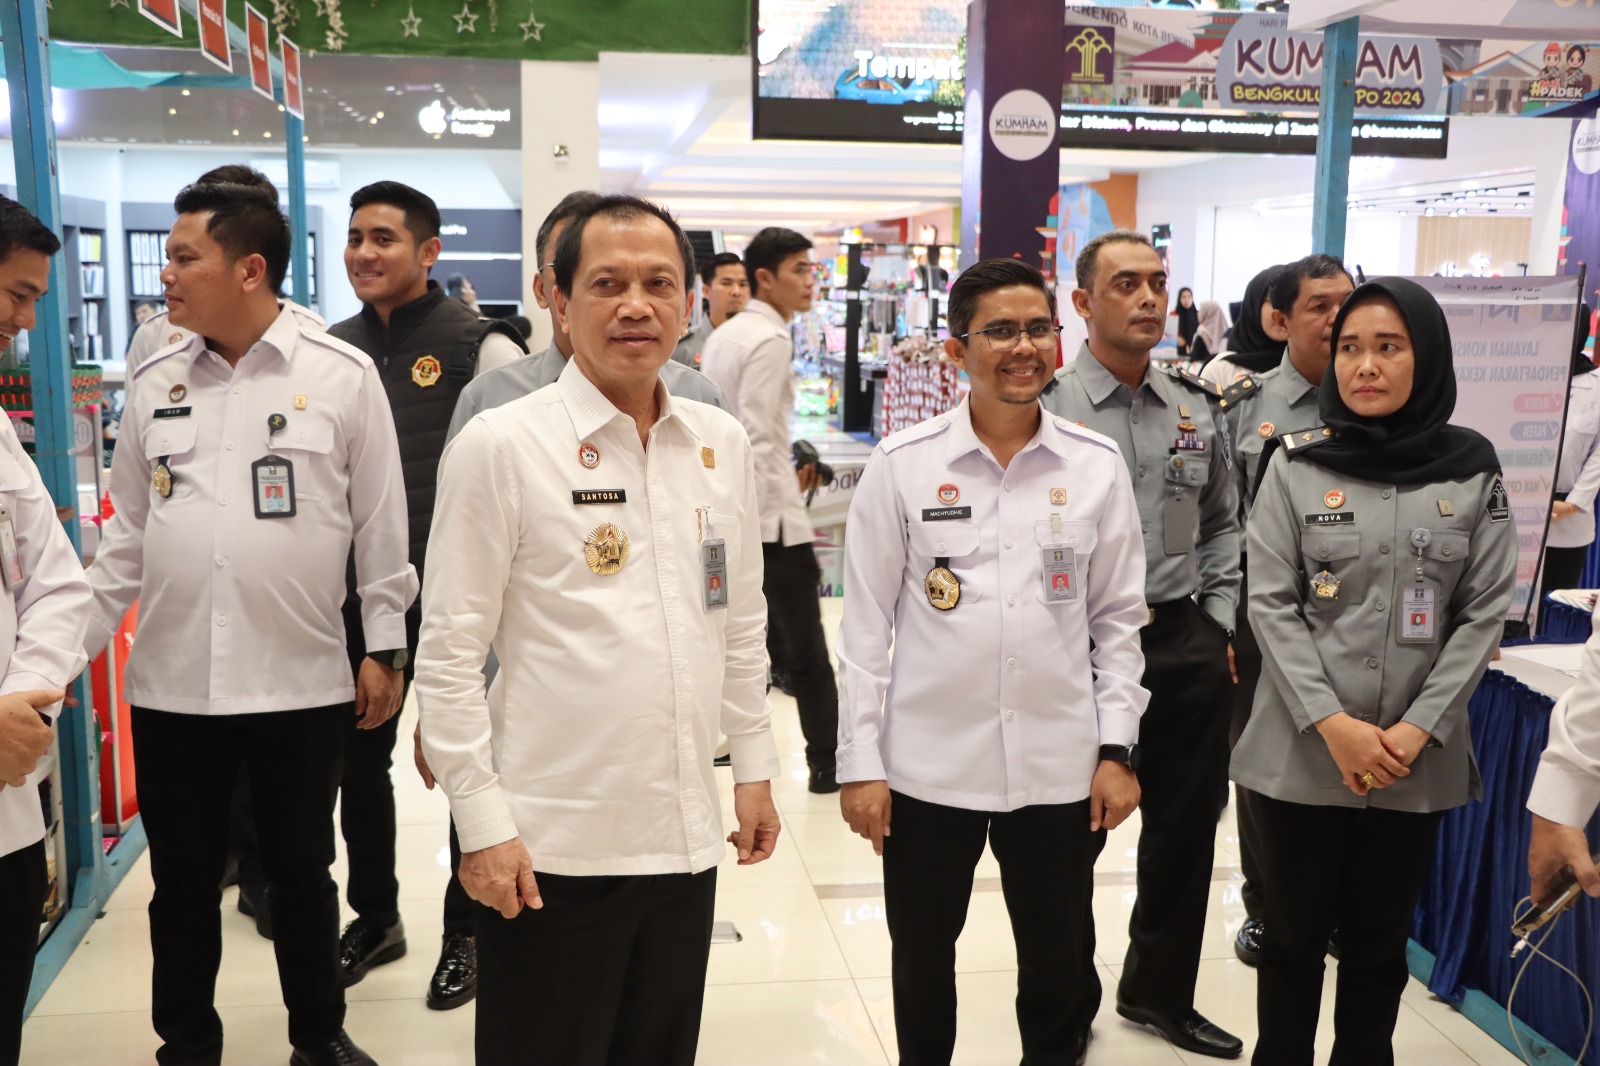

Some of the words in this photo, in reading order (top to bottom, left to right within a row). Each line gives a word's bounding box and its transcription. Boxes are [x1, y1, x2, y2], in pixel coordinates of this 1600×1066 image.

[1132, 20, 1159, 39] KOTA
[1259, 18, 1279, 28] HARI
[1237, 36, 1422, 81] KUMAM
[853, 50, 962, 86] Tempat
[1382, 90, 1421, 106] 2024
[995, 117, 1048, 130] KUMHAM
[1135, 116, 1180, 130] Promo
[1181, 118, 1207, 132] dan
[1208, 119, 1274, 136] Giveaway
[581, 492, 619, 501] SANTOSA
[1318, 514, 1341, 522] NOVA
